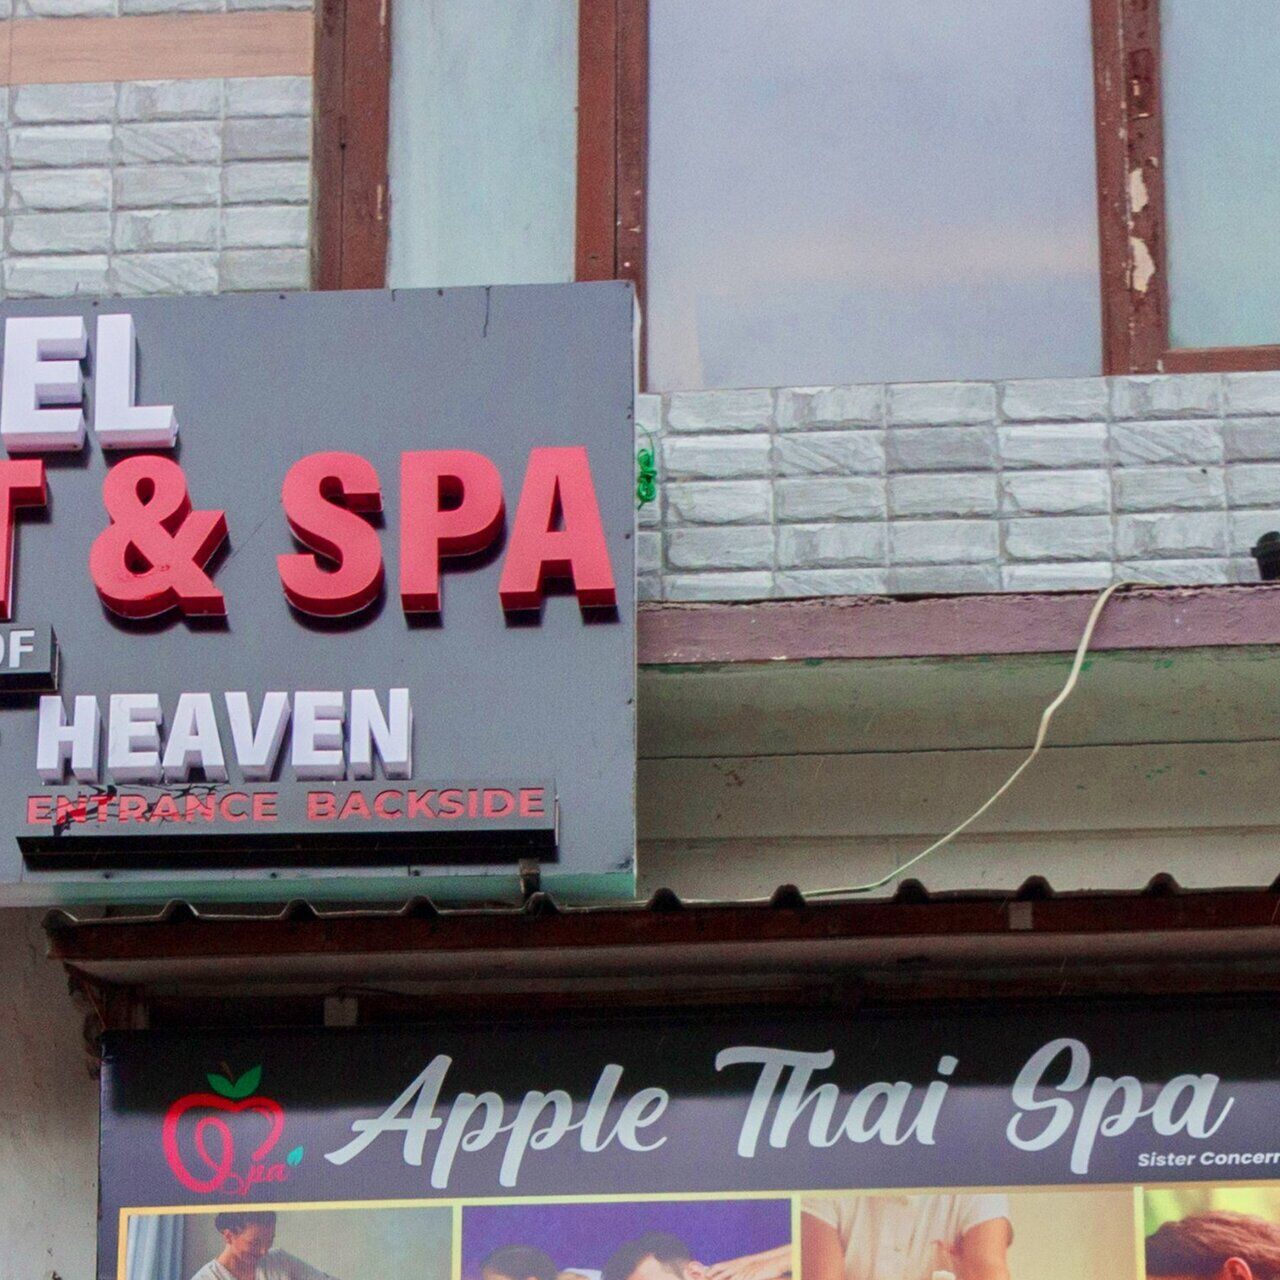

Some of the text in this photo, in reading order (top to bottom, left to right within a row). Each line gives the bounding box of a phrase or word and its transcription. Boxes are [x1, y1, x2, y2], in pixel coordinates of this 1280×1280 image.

[90, 455, 229, 620] &
[278, 447, 617, 618] SPA
[36, 688, 414, 785] HEAVEN
[27, 787, 545, 826] ENTRANCE BACKSIDE
[324, 1037, 1235, 1190] Apple Thai Spa
[1137, 1152, 1196, 1167] Sister
